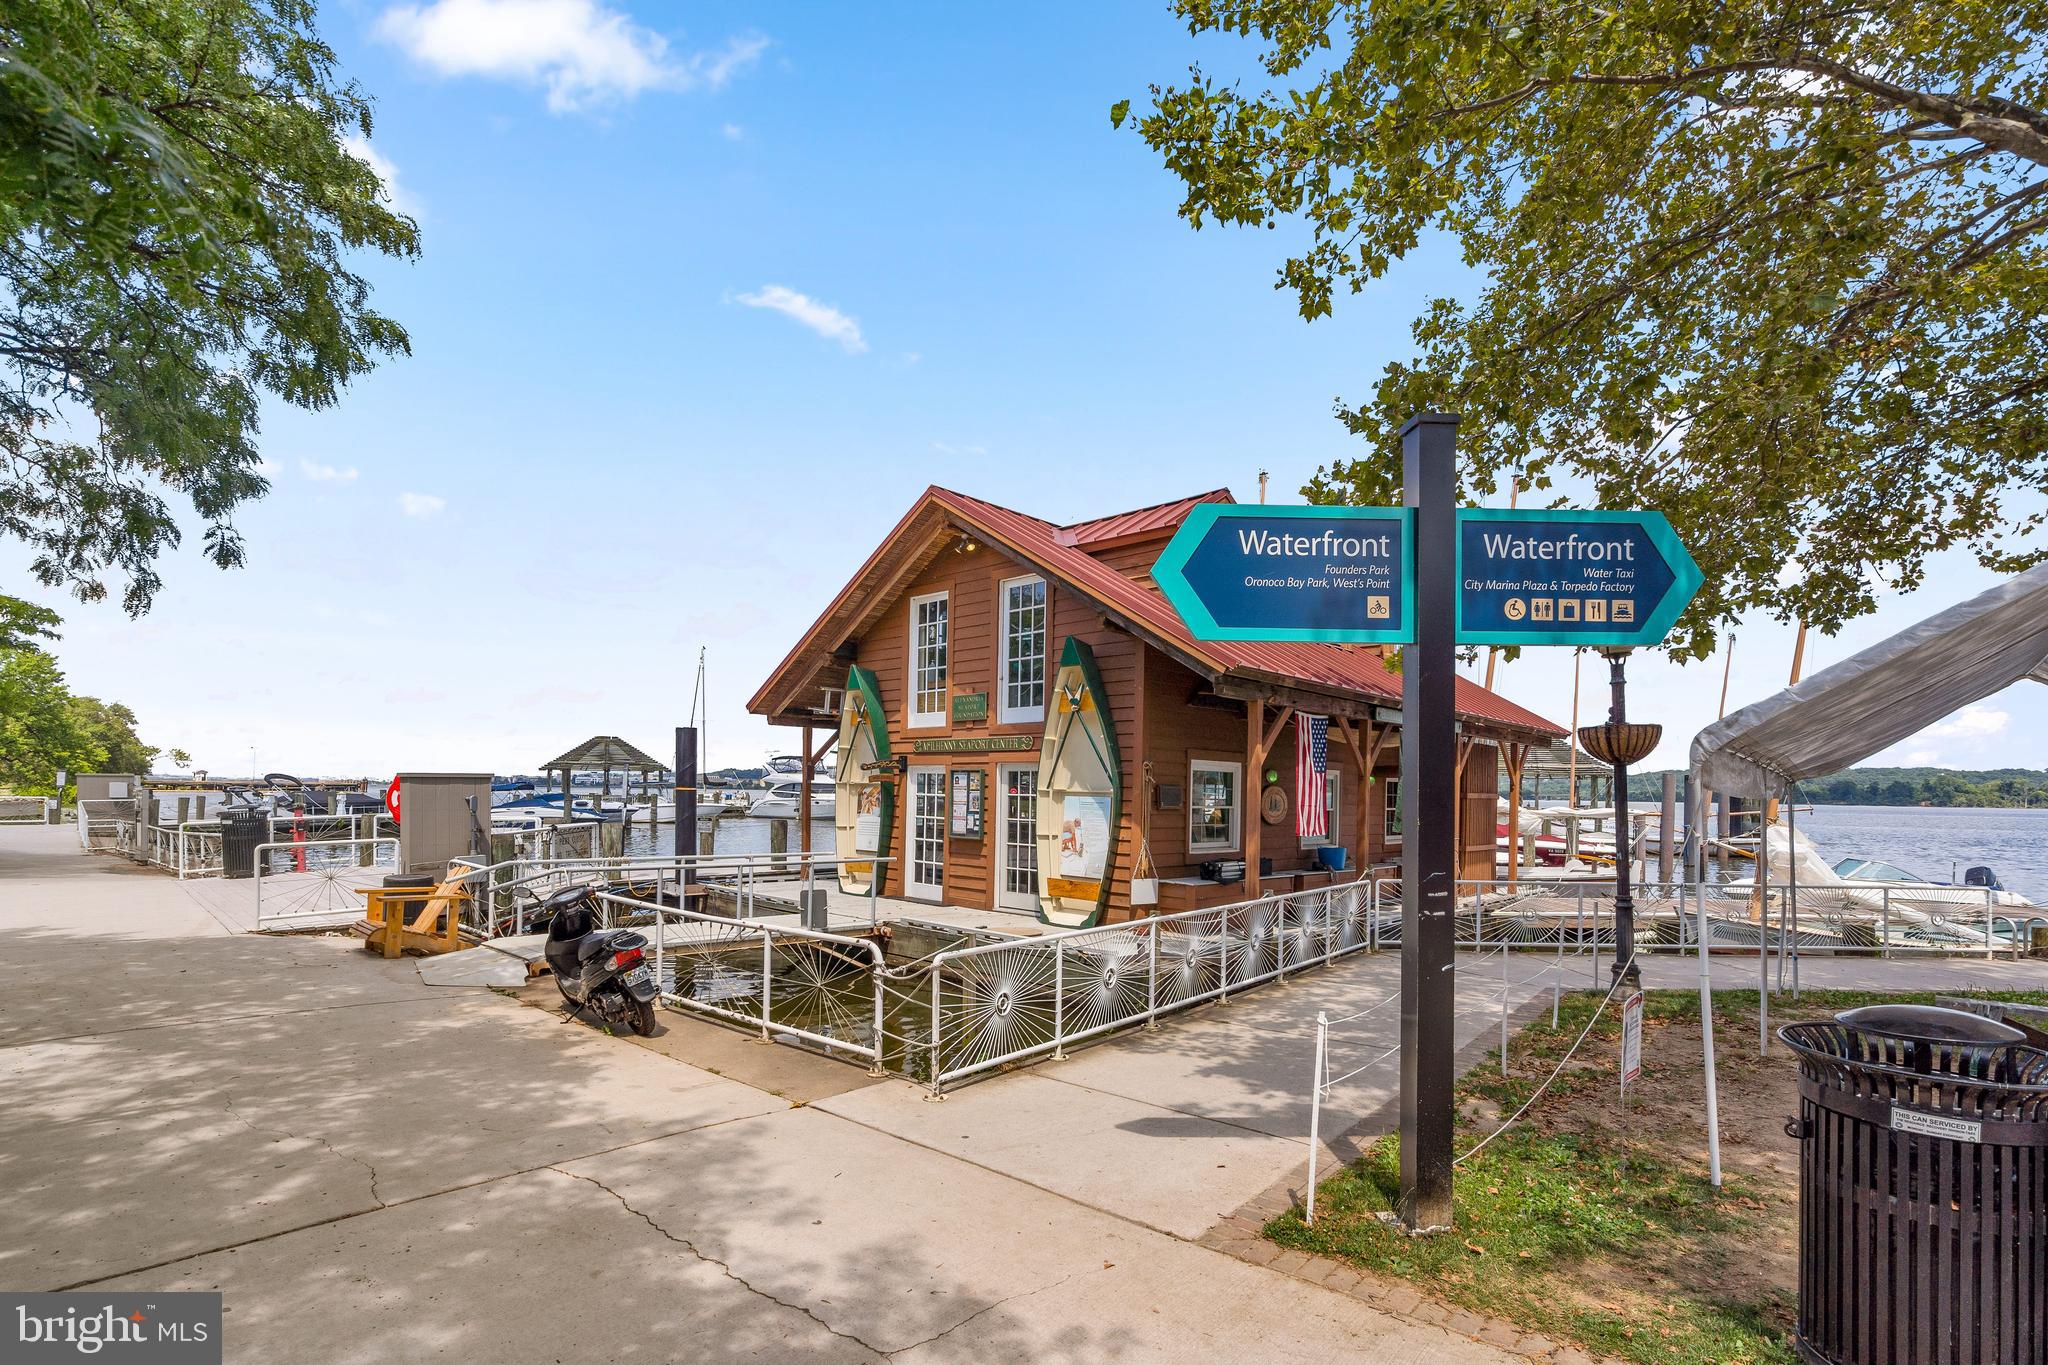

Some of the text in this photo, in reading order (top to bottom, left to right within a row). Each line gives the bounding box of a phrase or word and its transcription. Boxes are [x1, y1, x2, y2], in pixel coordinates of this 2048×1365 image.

[1238, 529, 1390, 558] Waterfront
[1483, 533, 1635, 561] Waterfront
[1325, 564, 1390, 575] Founders Park
[1583, 568, 1635, 578] Water Taxi
[1244, 576, 1390, 589] Oronoco Bay Park, West's Point
[1464, 579, 1635, 593] City Marina Plaza & Torpedo Factory
[959, 739, 990, 750] SEAPORT
[991, 738, 1018, 749] CENTER
[1894, 1111, 1911, 1120] THIS
[1912, 1115, 1928, 1123] CAN
[1929, 1119, 1967, 1131] SERVICED
